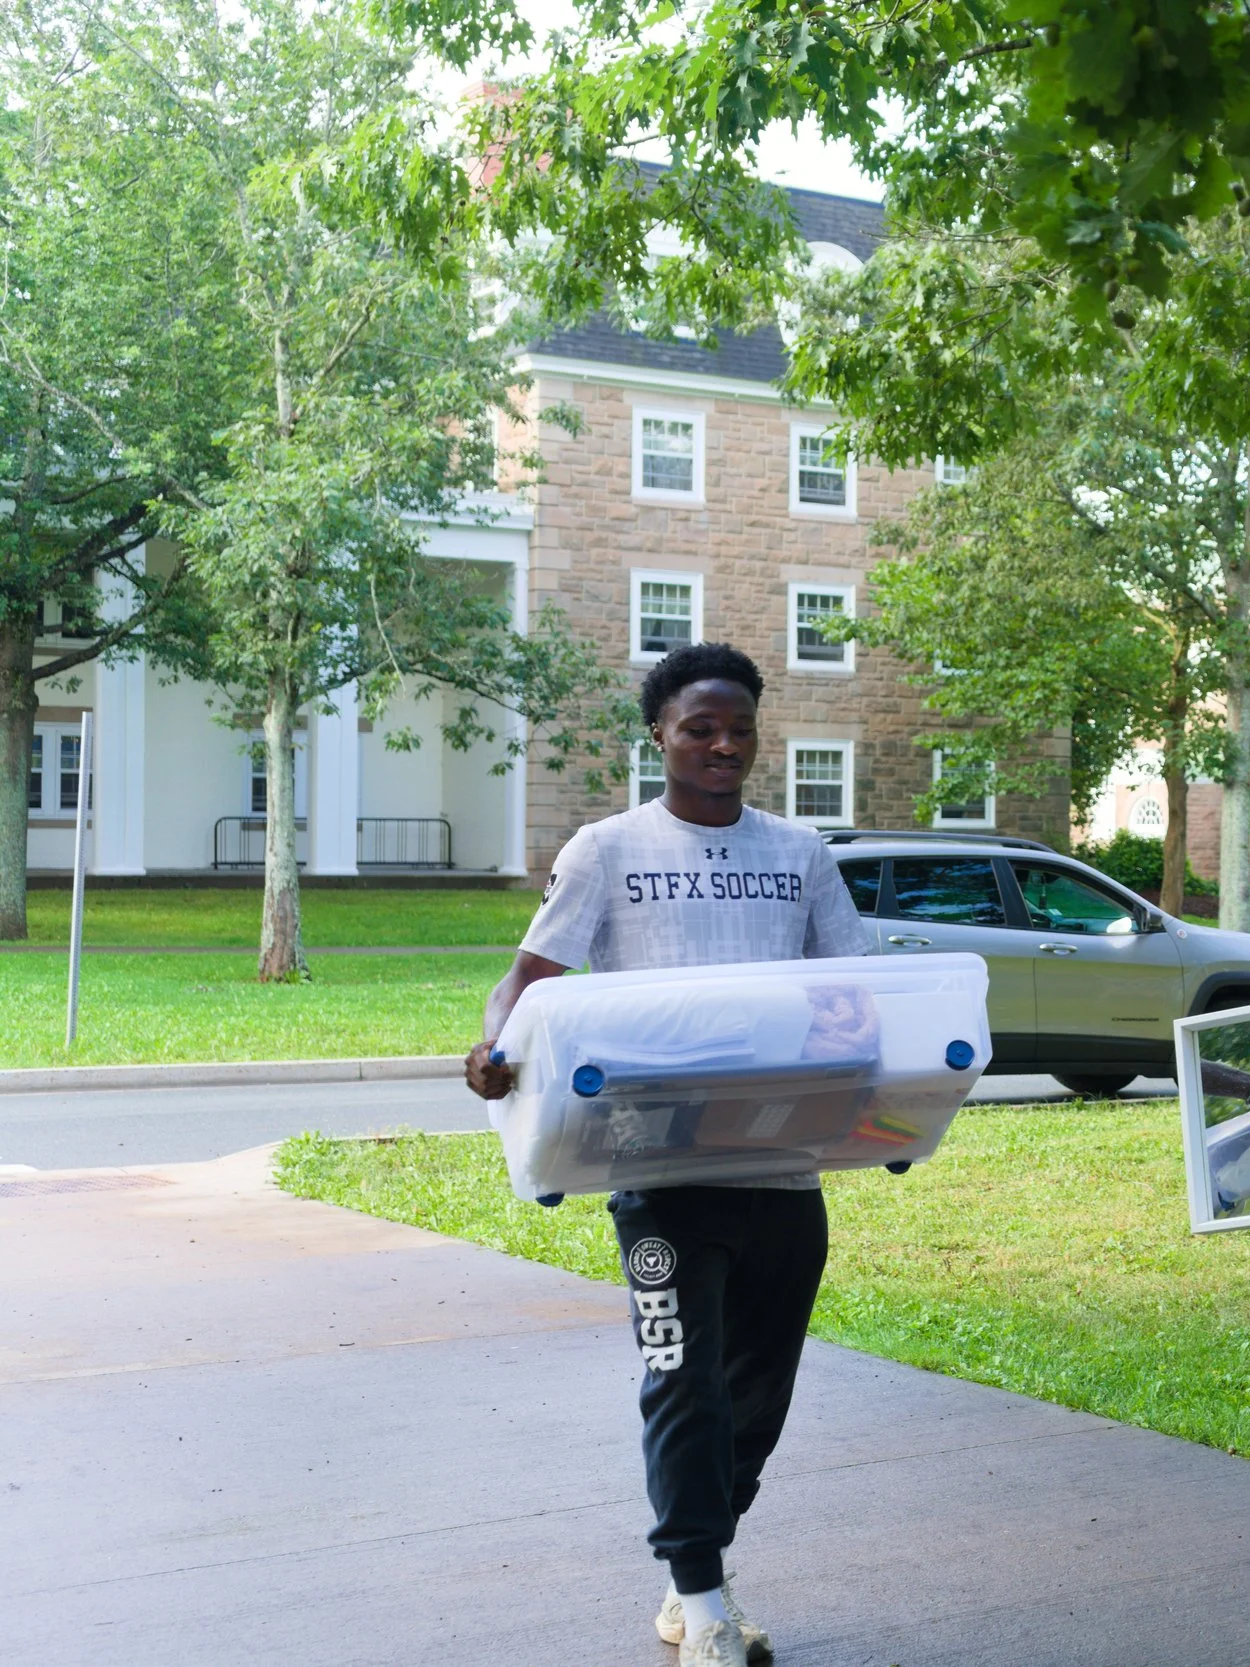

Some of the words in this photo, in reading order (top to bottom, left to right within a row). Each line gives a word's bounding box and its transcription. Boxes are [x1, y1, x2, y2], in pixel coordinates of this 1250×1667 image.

[626, 872, 704, 903] STFX
[712, 872, 801, 903] SOCCER
[634, 1287, 684, 1373] BSR
